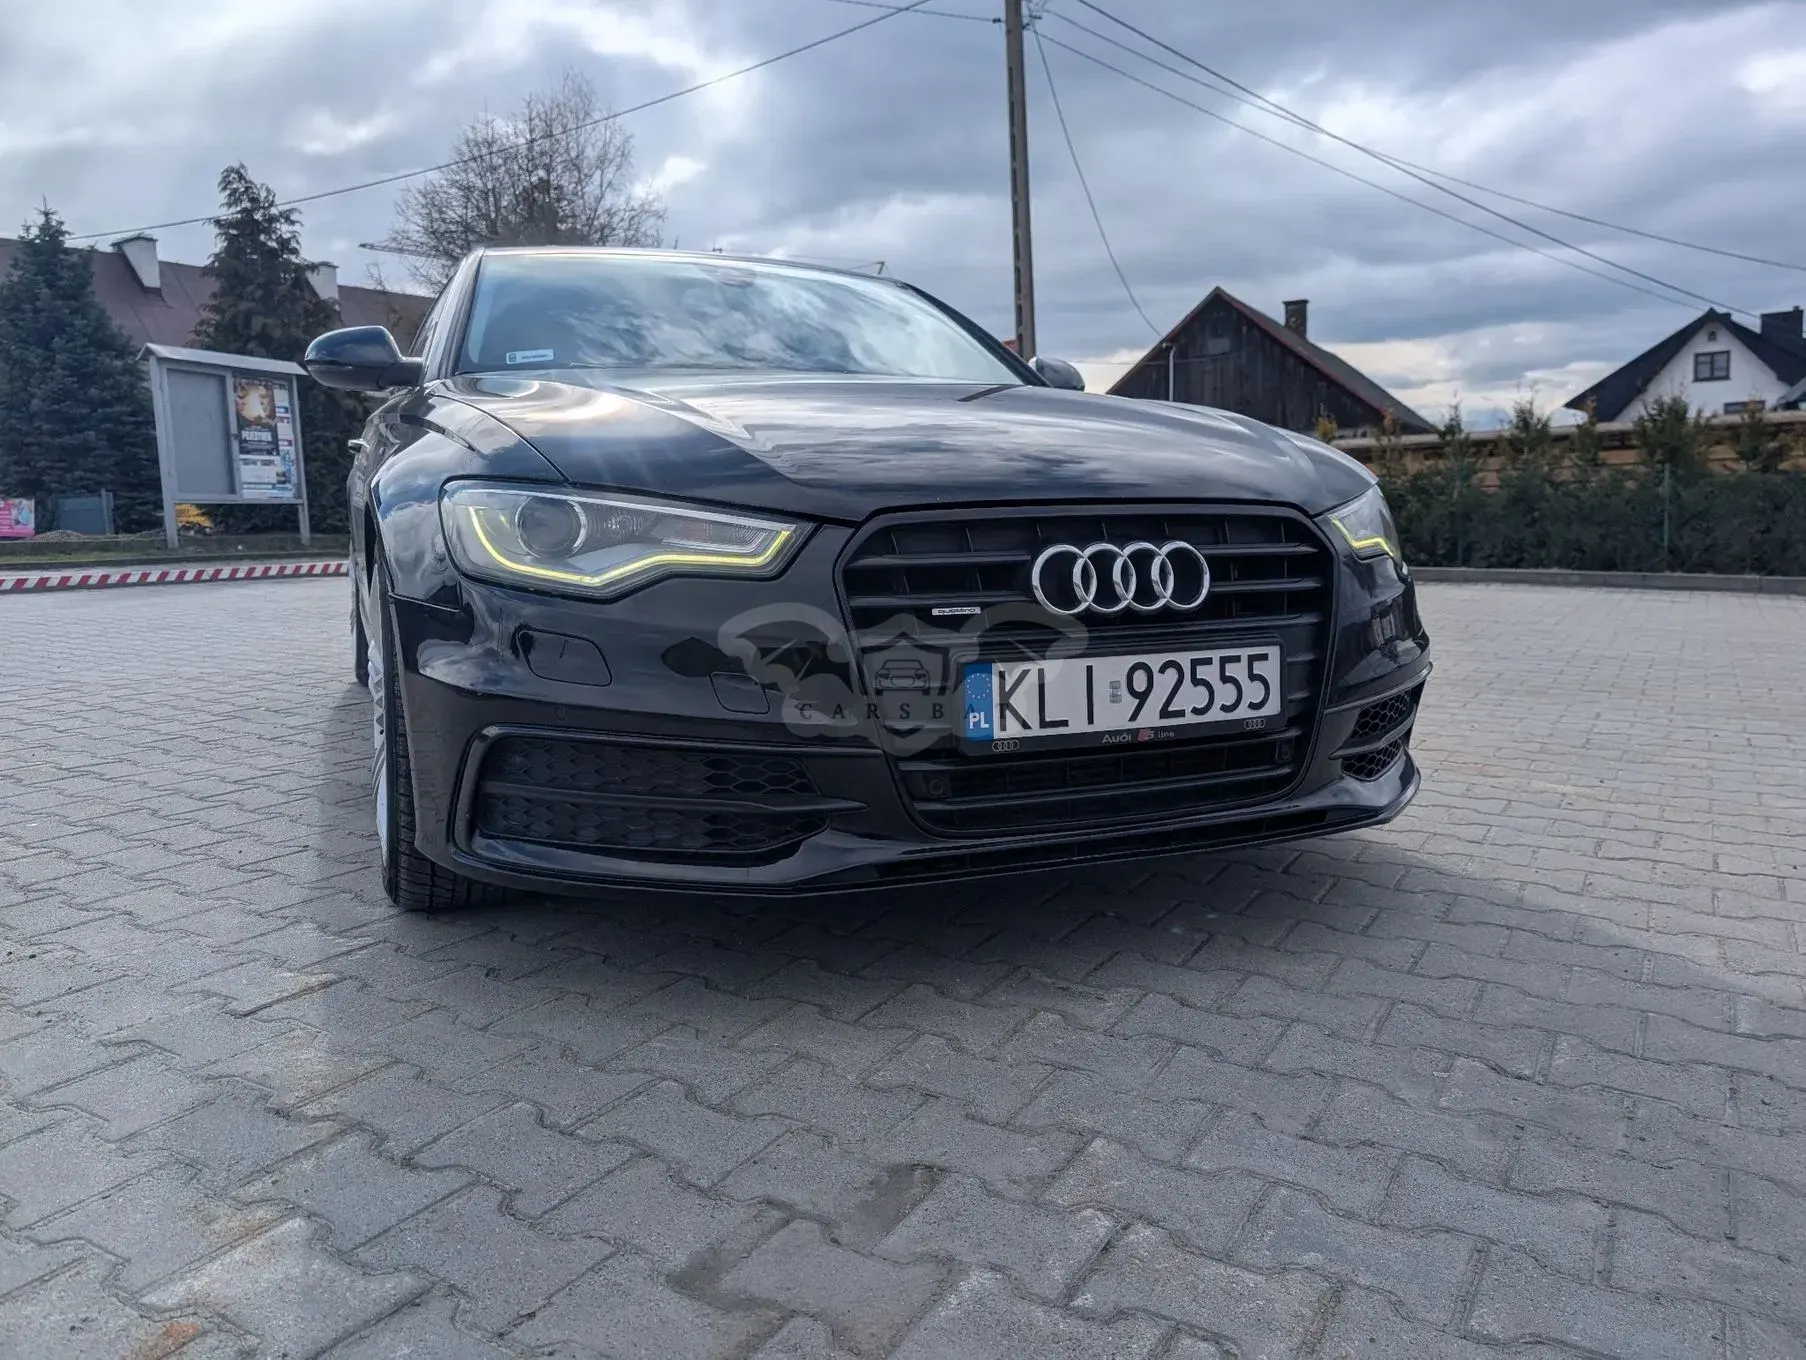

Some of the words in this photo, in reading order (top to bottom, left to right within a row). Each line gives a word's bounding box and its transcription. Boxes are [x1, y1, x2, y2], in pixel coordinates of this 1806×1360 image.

[936, 606, 977, 615] quattro
[998, 663, 1095, 732] KLI
[1124, 652, 1272, 724] 92555
[969, 711, 990, 730] PL
[1101, 732, 1132, 744] Audi
[1157, 731, 1176, 739] line
